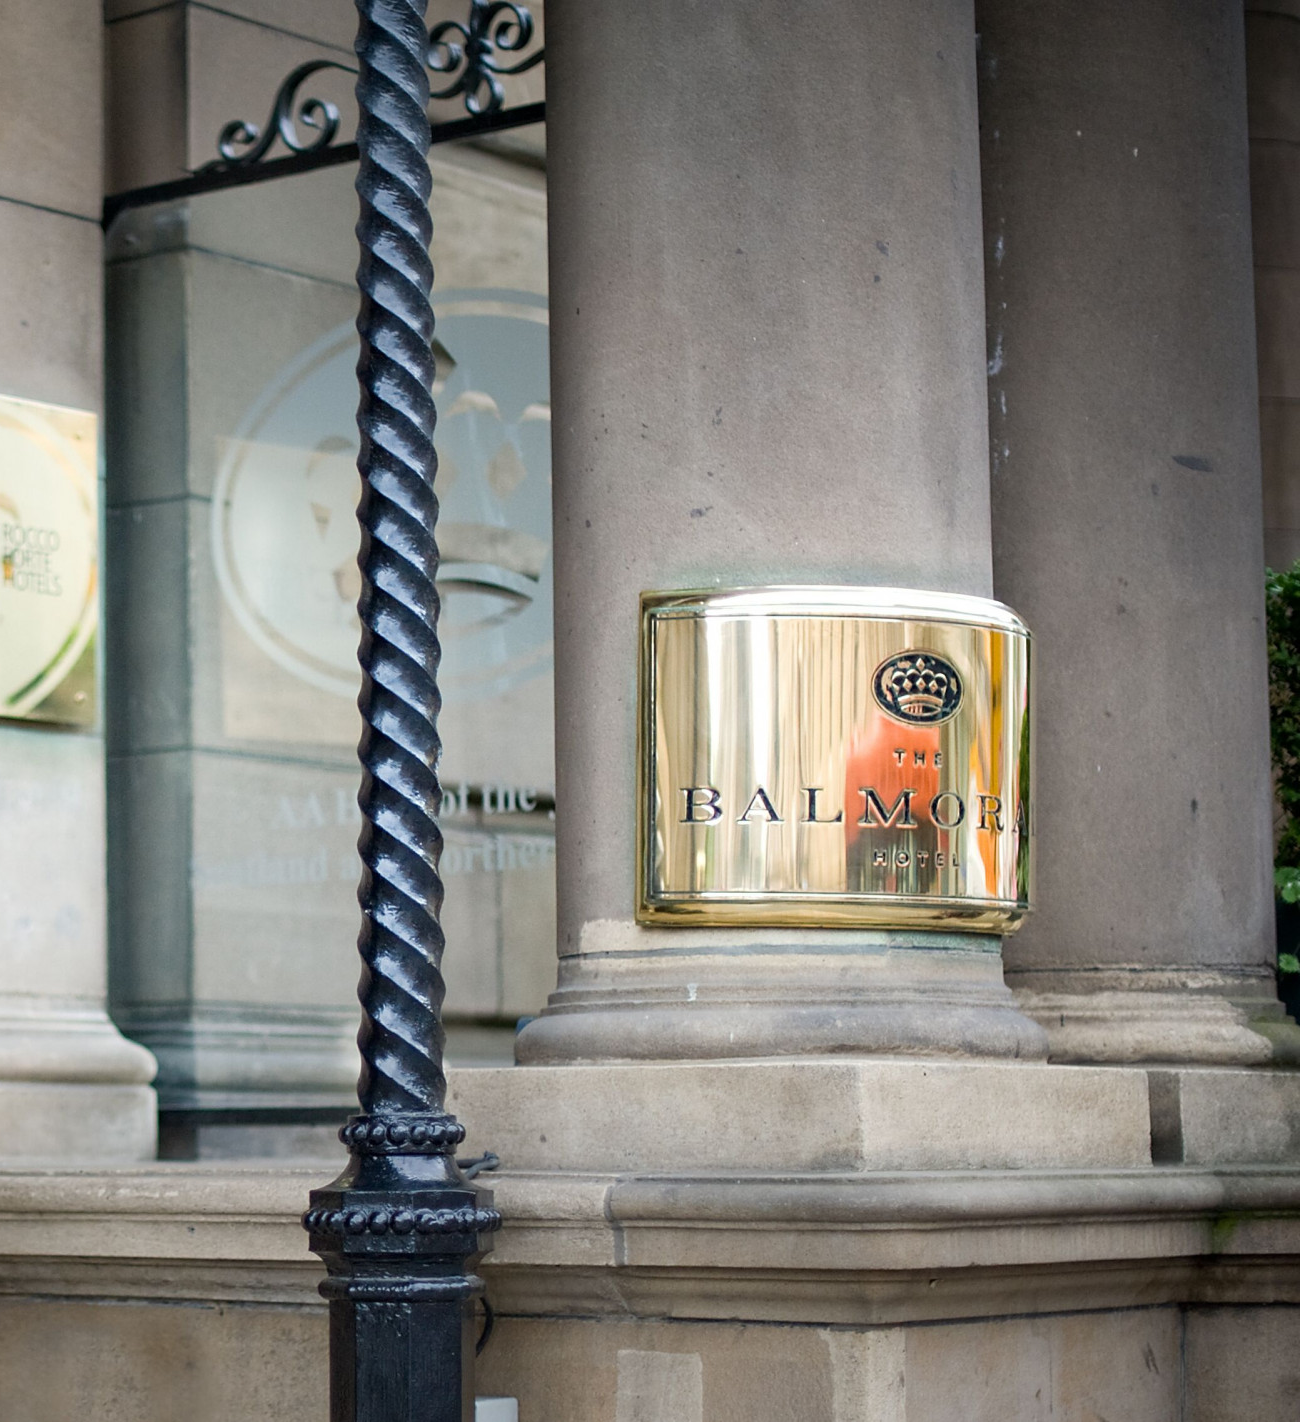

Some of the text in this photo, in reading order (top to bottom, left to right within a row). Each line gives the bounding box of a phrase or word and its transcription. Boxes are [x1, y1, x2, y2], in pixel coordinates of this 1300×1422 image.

[3, 522, 61, 552] ROCCO
[3, 568, 63, 597] HOTELS
[892, 748, 943, 768] THE
[440, 779, 468, 816] of
[482, 783, 537, 814] the
[679, 784, 1028, 836] BALMORA
[873, 849, 960, 867] HOTEL
